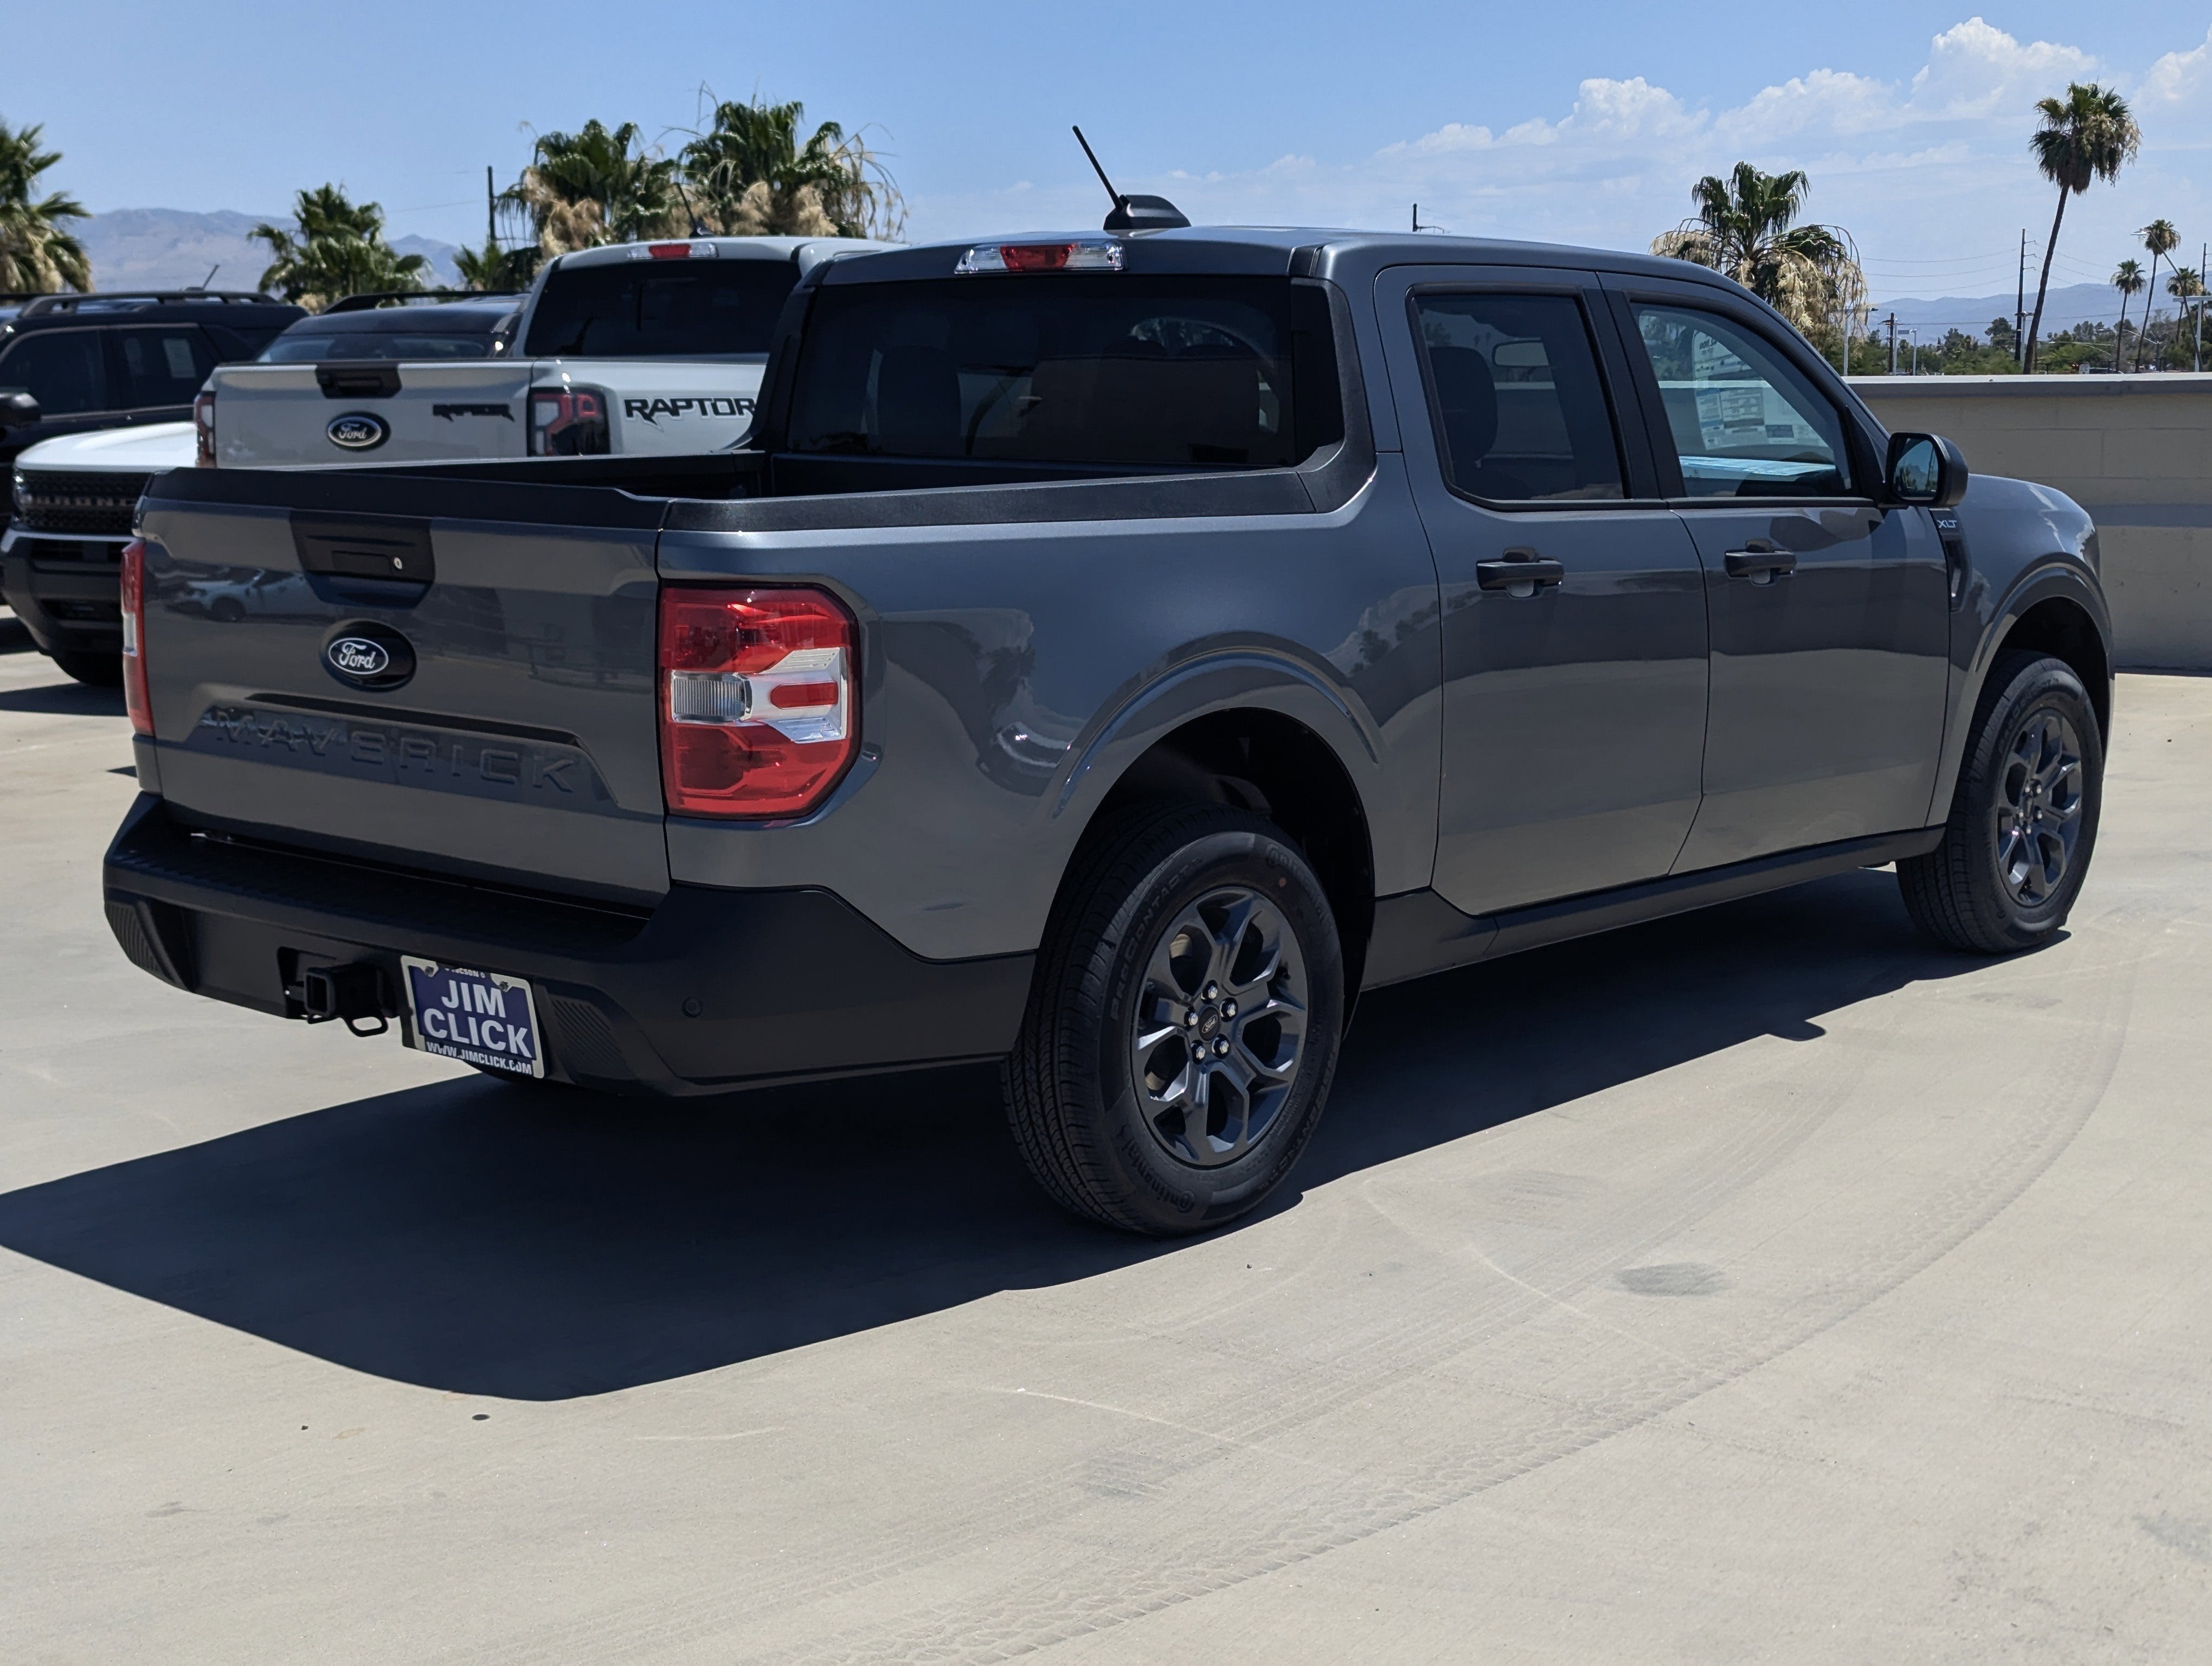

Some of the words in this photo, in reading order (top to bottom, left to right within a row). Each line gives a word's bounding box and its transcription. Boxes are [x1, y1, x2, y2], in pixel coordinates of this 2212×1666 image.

[624, 398, 757, 426] RAPTOR
[1937, 519, 1957, 528] XLT
[338, 642, 376, 669] Ford
[216, 710, 574, 792] MAVERICK
[441, 979, 506, 1018] JIM
[423, 1008, 532, 1058] CLICK
[426, 1041, 532, 1075] WWW.JIMCLICK.COM
[1120, 1137, 1195, 1214] Continental
